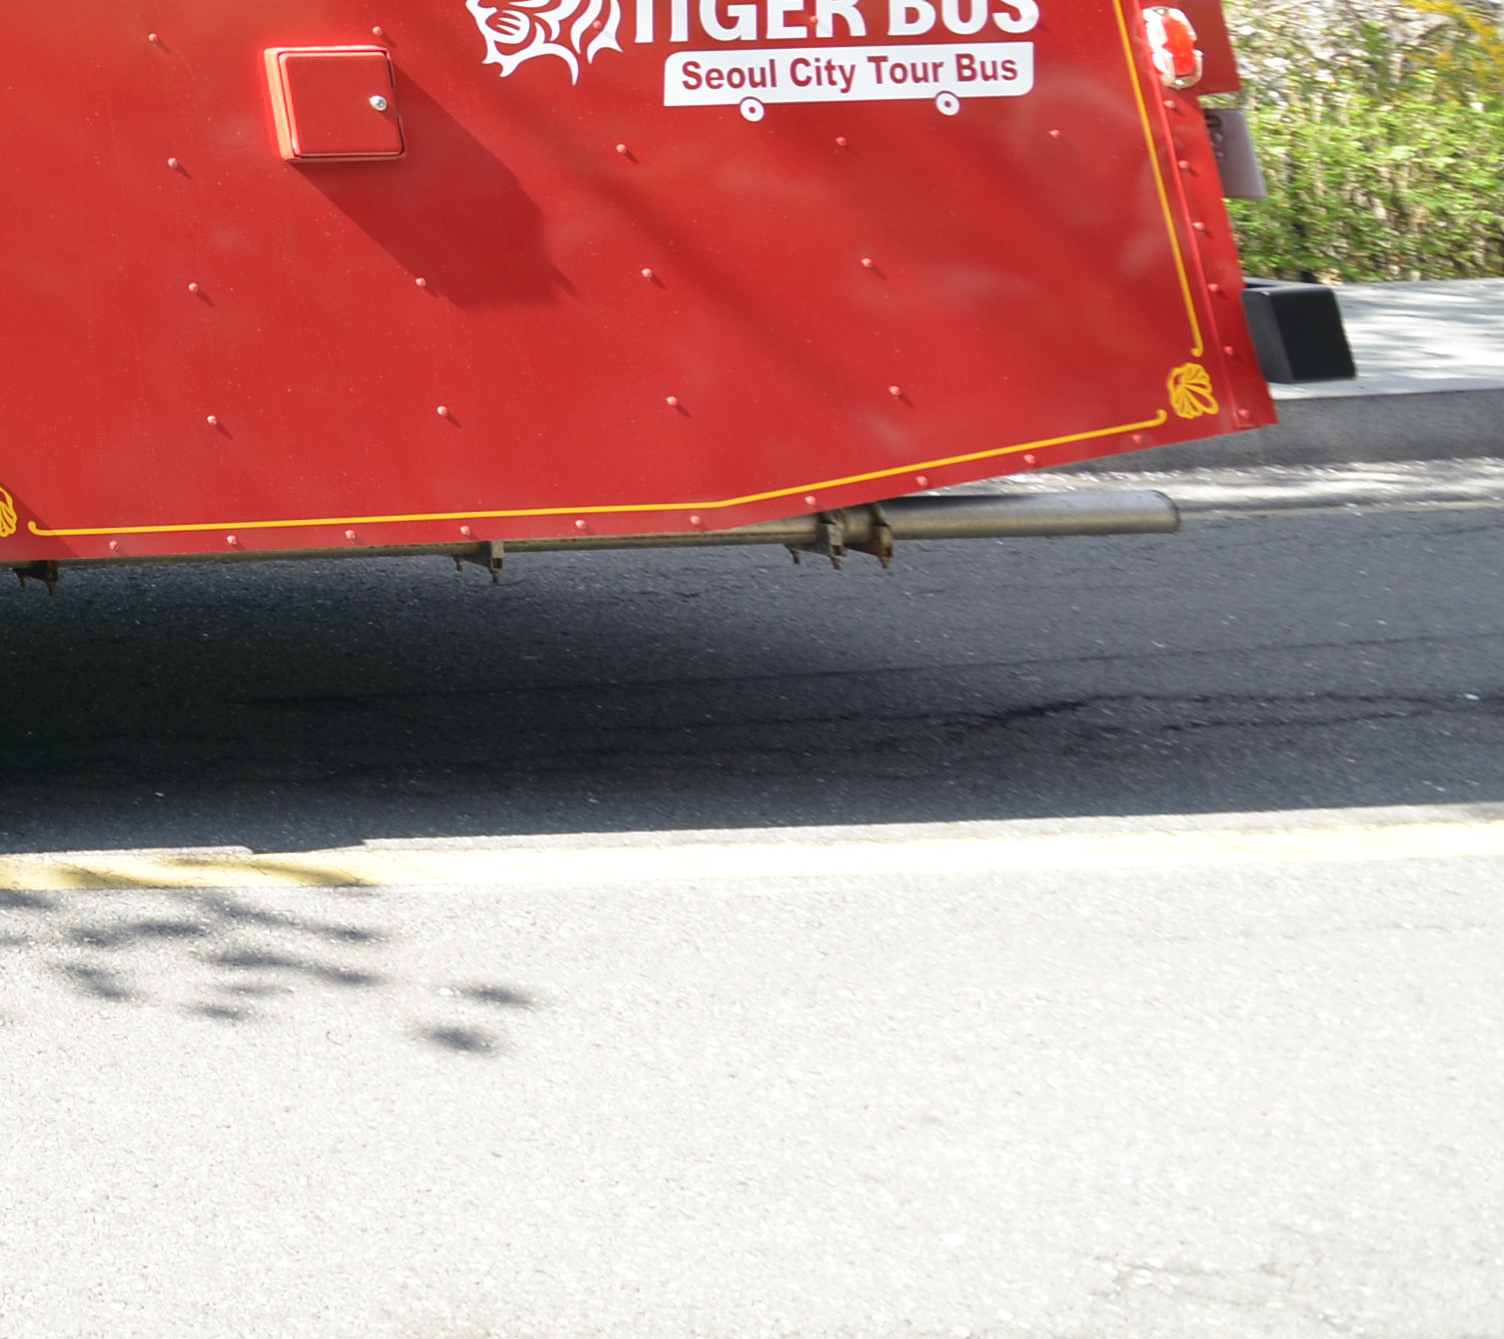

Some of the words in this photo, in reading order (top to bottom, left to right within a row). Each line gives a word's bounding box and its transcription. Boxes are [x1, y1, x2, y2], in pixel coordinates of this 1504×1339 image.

[682, 58, 777, 91] Seoul
[789, 57, 856, 94] City
[866, 55, 944, 85] Tour
[955, 53, 1018, 82] Bus
